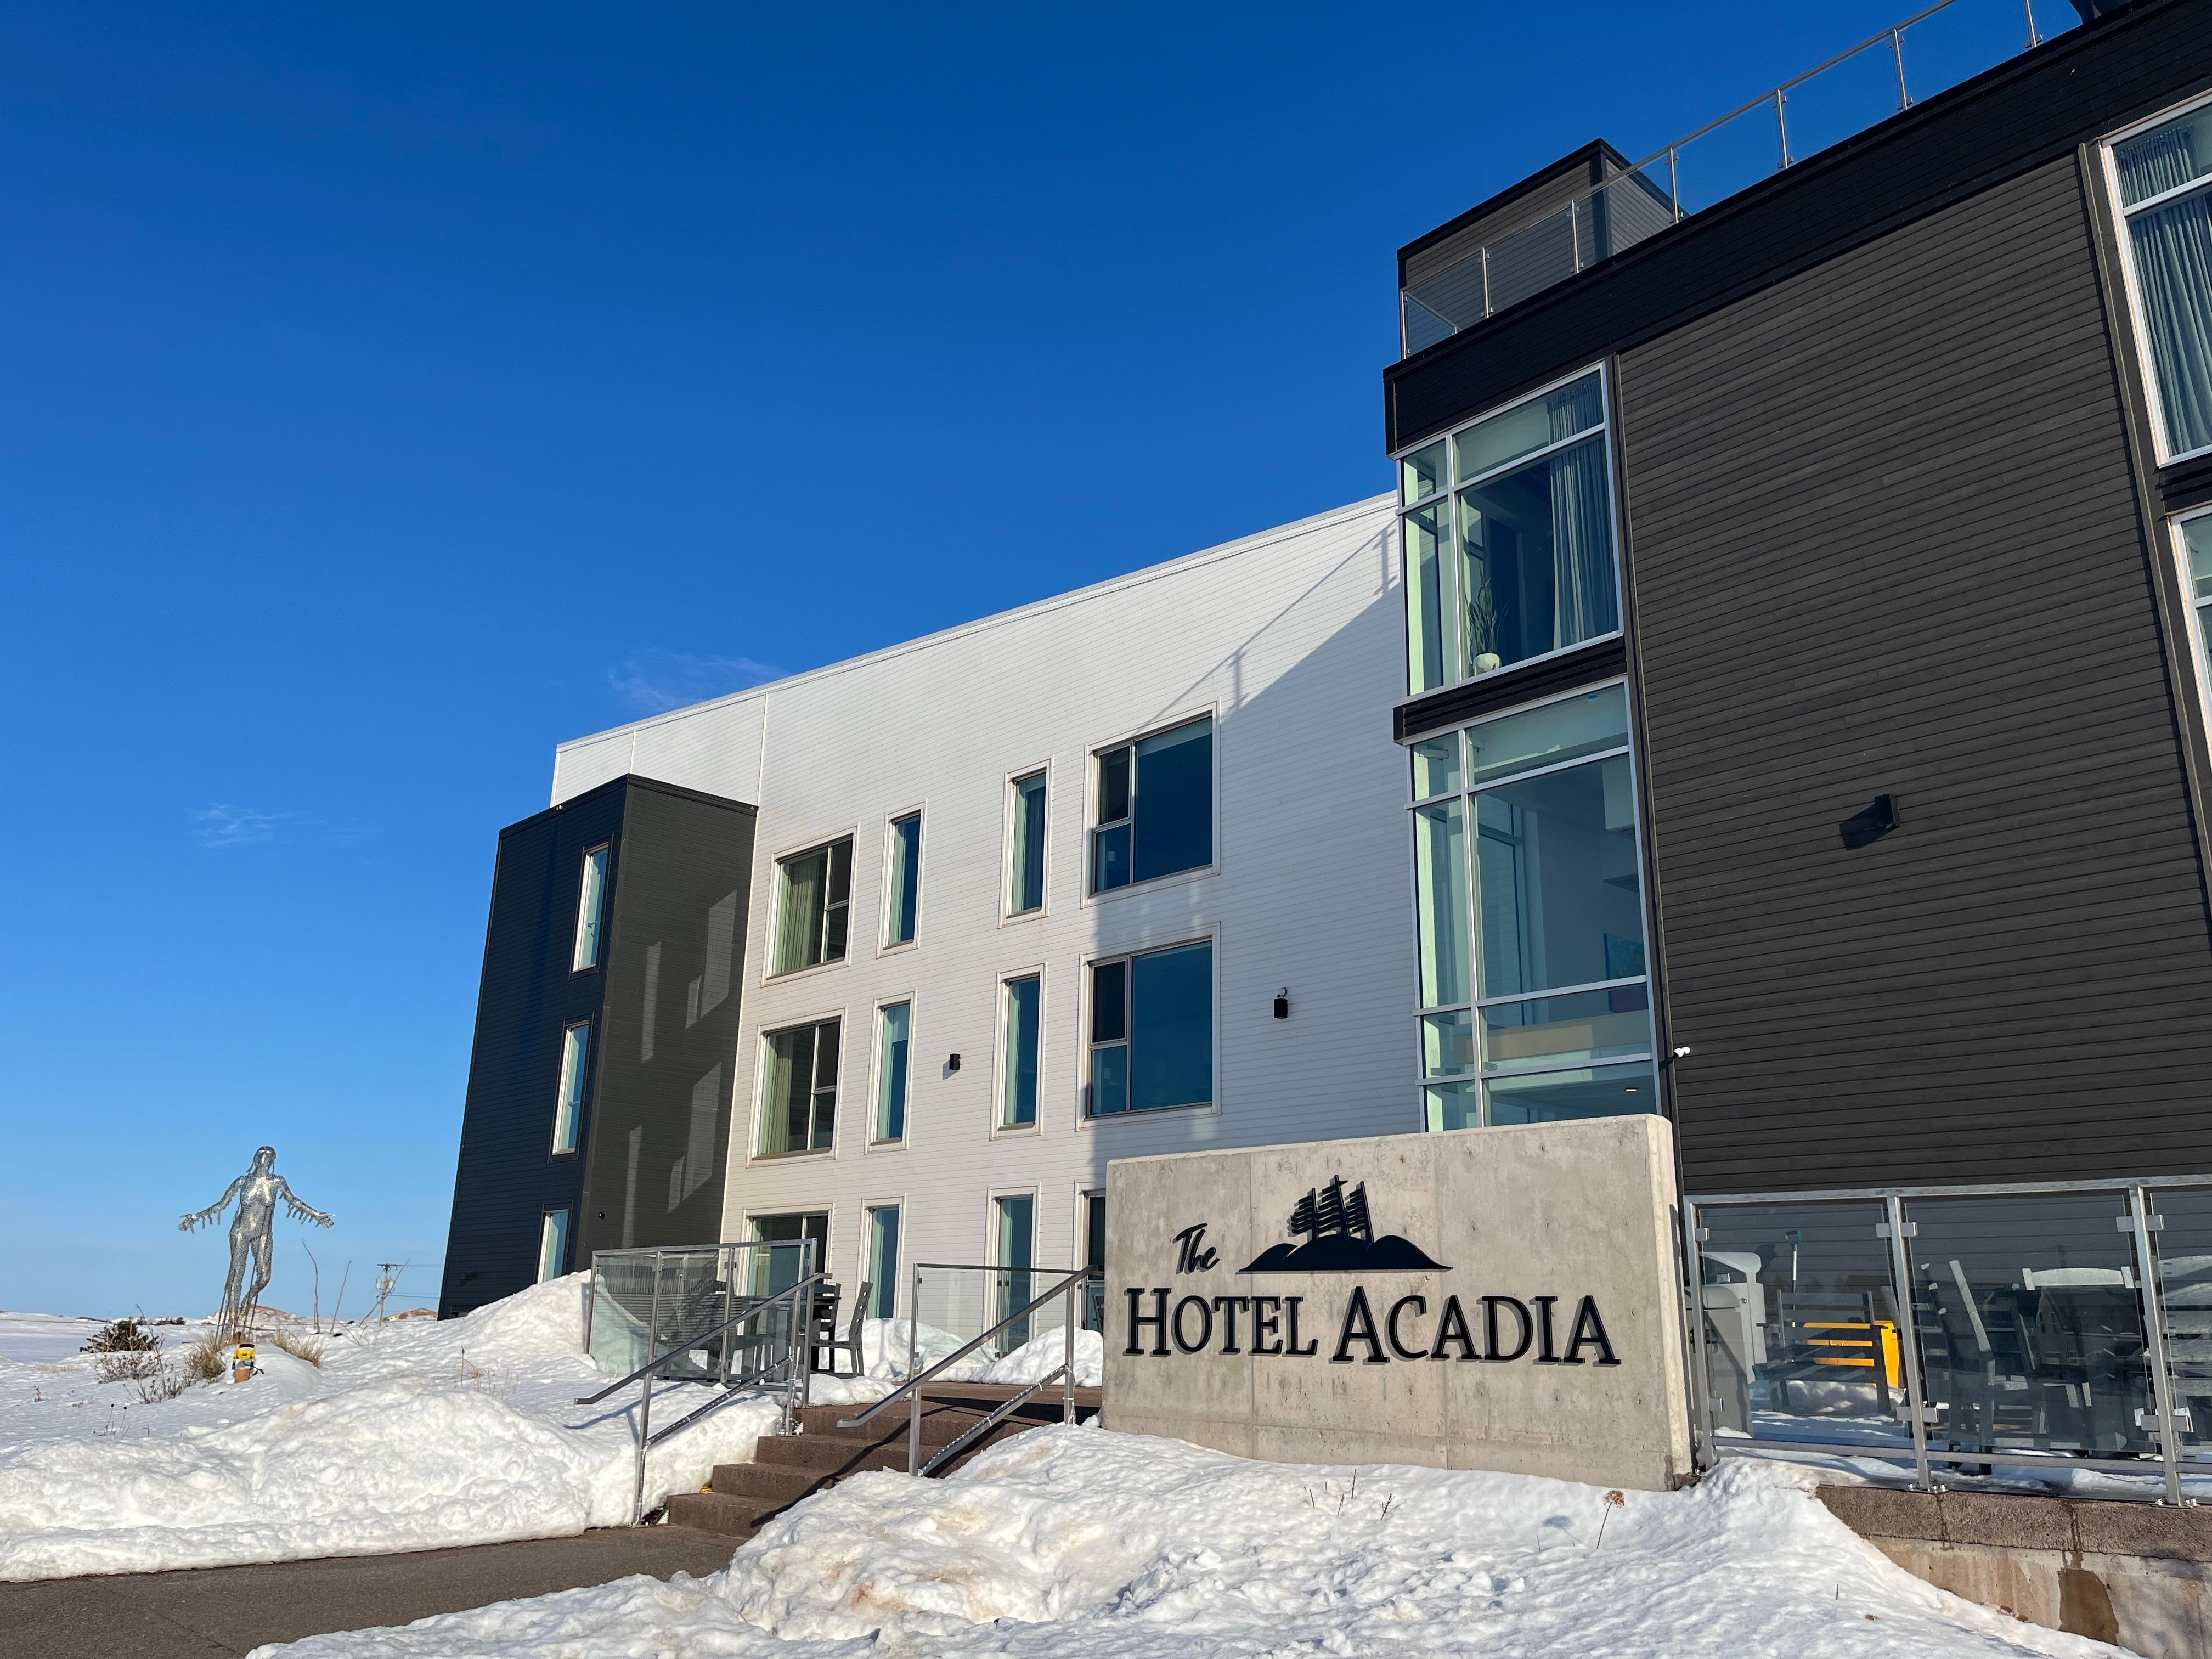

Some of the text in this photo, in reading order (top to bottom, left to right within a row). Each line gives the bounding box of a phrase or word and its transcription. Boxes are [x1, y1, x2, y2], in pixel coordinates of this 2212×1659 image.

[1173, 1223, 1220, 1273] The
[1124, 1286, 1622, 1365] HOTEL ACADIA
